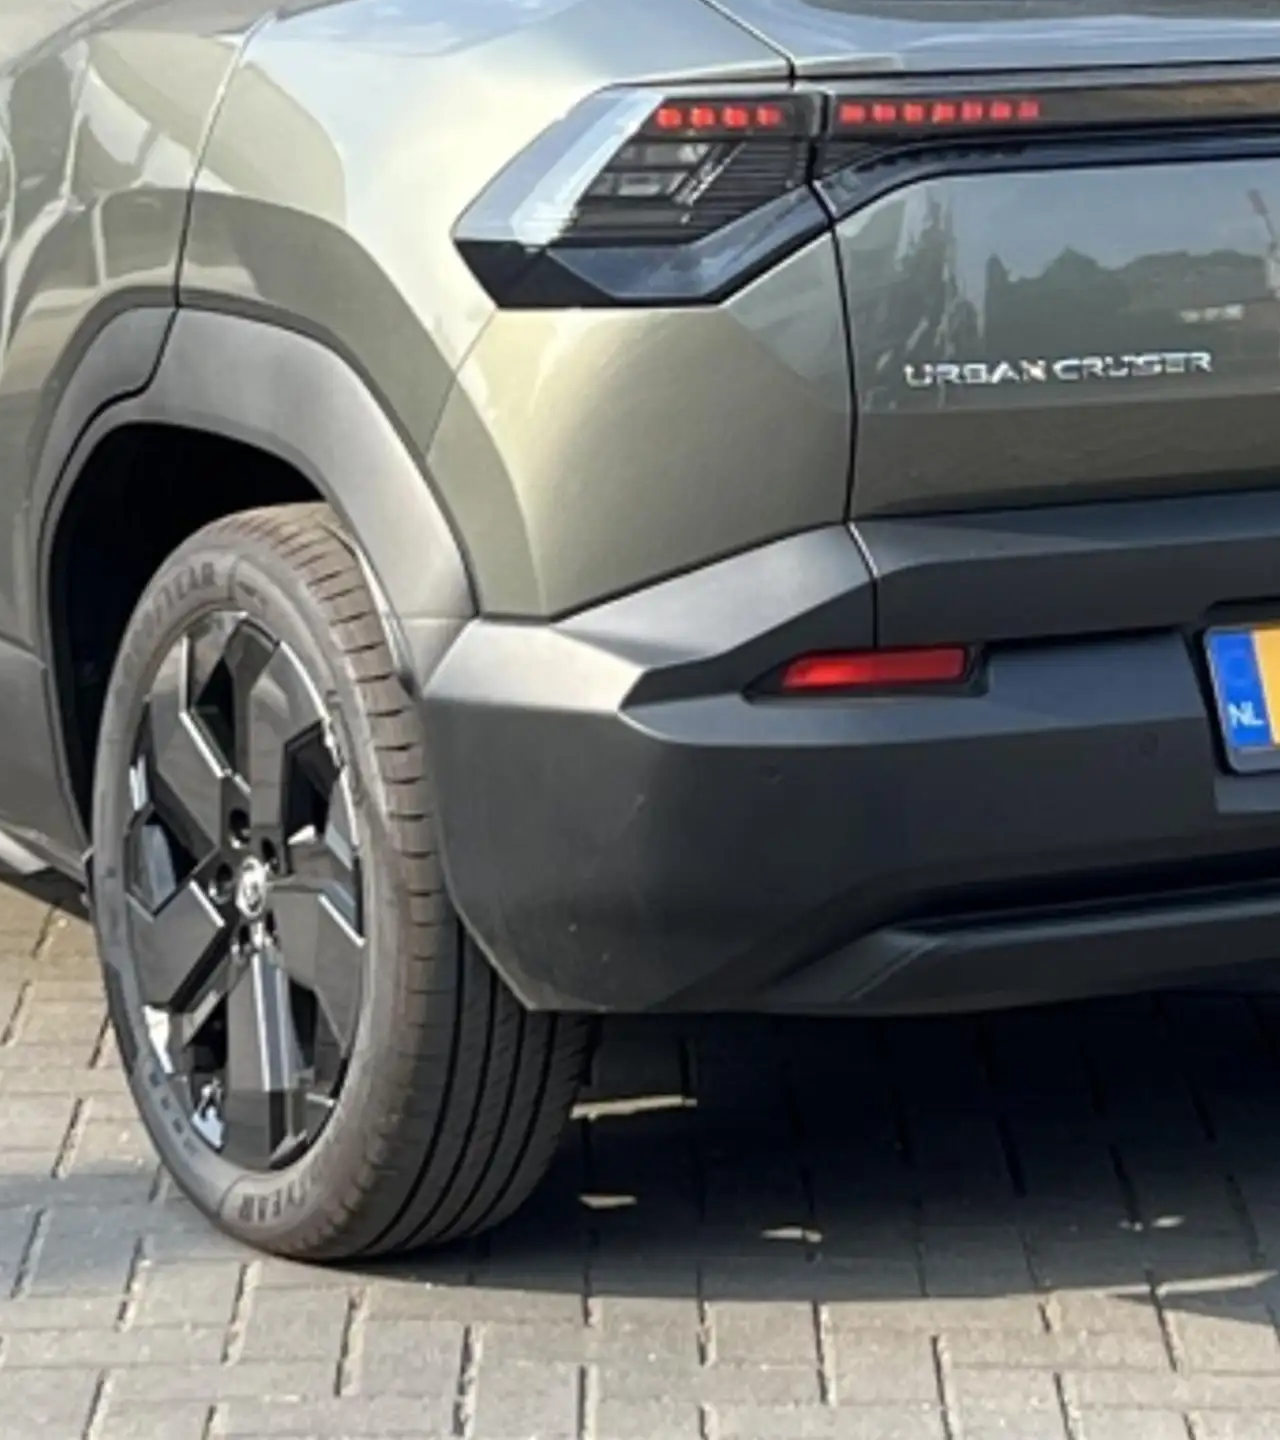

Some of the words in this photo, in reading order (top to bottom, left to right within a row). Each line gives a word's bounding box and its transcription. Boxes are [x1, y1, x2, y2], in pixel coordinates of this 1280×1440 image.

[904, 359, 1047, 388] URBAN
[1052, 350, 1215, 381] CRUISER
[1228, 702, 1264, 727] NL
